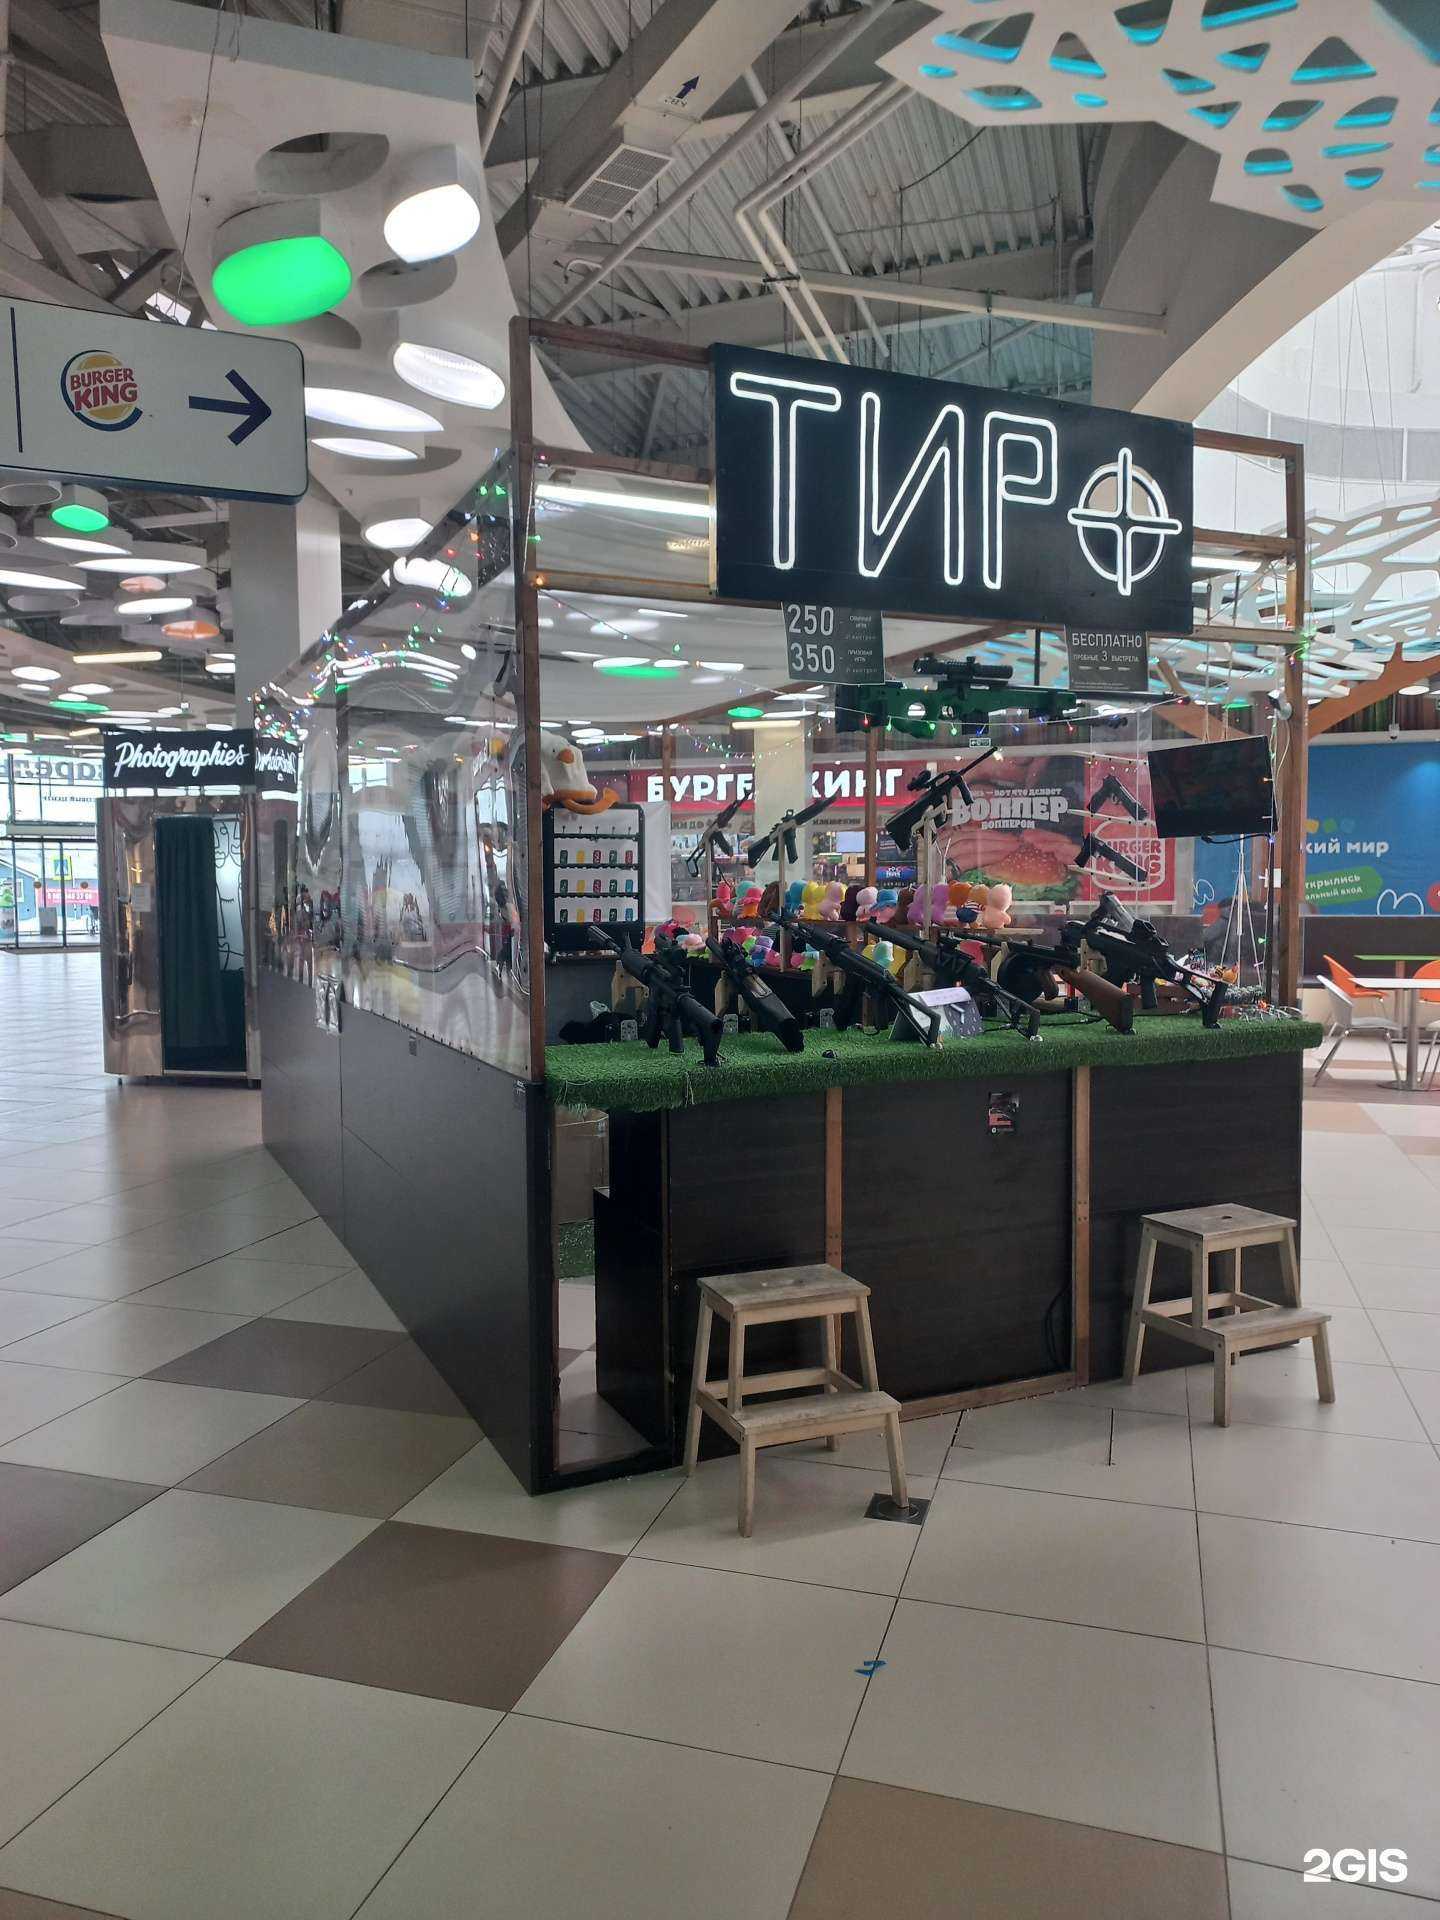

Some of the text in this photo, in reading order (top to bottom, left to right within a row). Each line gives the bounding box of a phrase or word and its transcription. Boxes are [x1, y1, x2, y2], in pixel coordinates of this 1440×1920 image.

[71, 368, 134, 391] BURGER
[74, 382, 138, 410] KING
[730, 371, 1058, 590] ТИР
[787, 604, 834, 636] 250
[1071, 633, 1143, 649] БЕСПЛАТНО
[790, 642, 835, 674] 350
[1102, 650, 1108, 662] 3
[113, 740, 250, 778] Photographies
[647, 773, 755, 802] БУРГЕ
[952, 796, 1068, 827] ВОППЕР
[1106, 840, 1162, 854] URGER
[1347, 841, 1390, 857] мир
[1305, 874, 1361, 890] ткрылись
